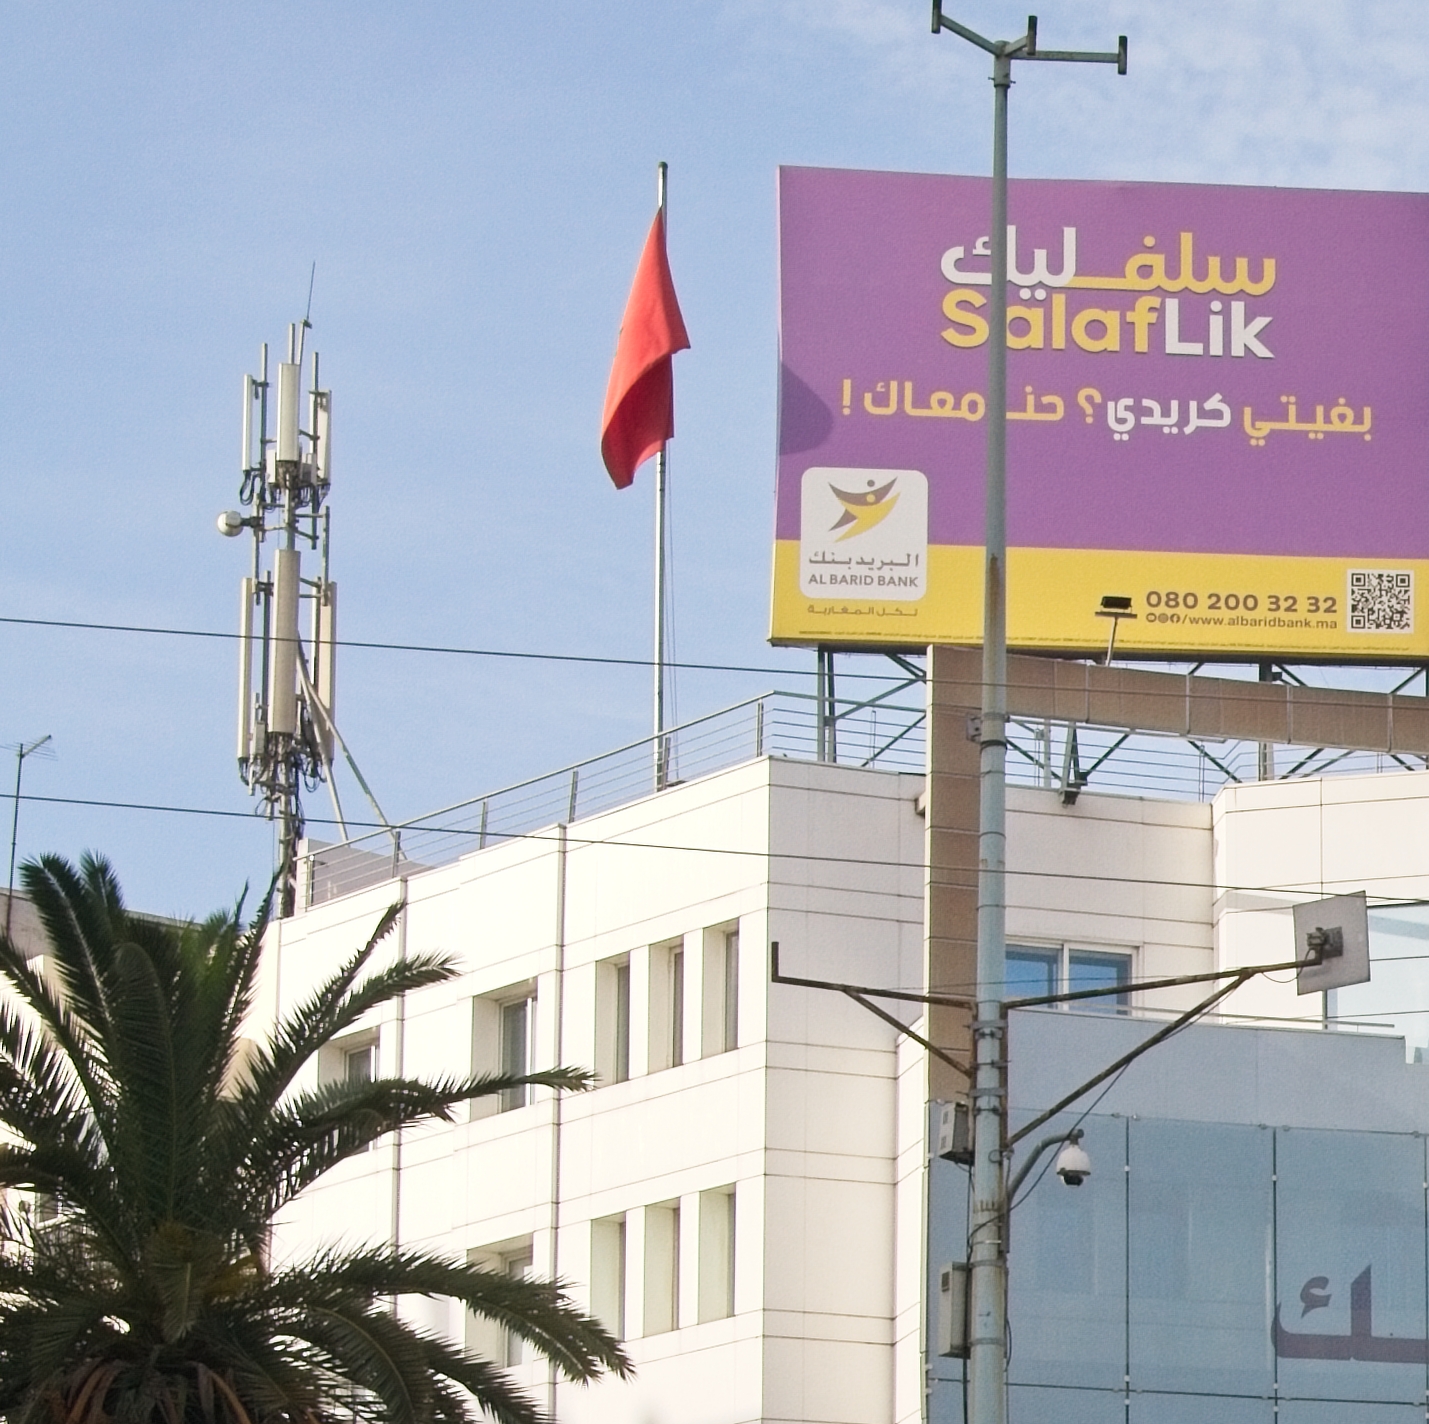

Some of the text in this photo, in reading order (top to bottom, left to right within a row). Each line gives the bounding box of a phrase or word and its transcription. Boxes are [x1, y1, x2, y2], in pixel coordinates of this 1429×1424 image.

[940, 289, 1275, 359] SalafLik
[863, 380, 985, 422] معاك
[999, 386, 1064, 422] حن
[1244, 396, 1371, 447] بغيتي
[808, 551, 919, 570] البريد بنك
[808, 573, 919, 588] AL BARID BANK
[1146, 590, 1337, 614] 080 200 32 32
